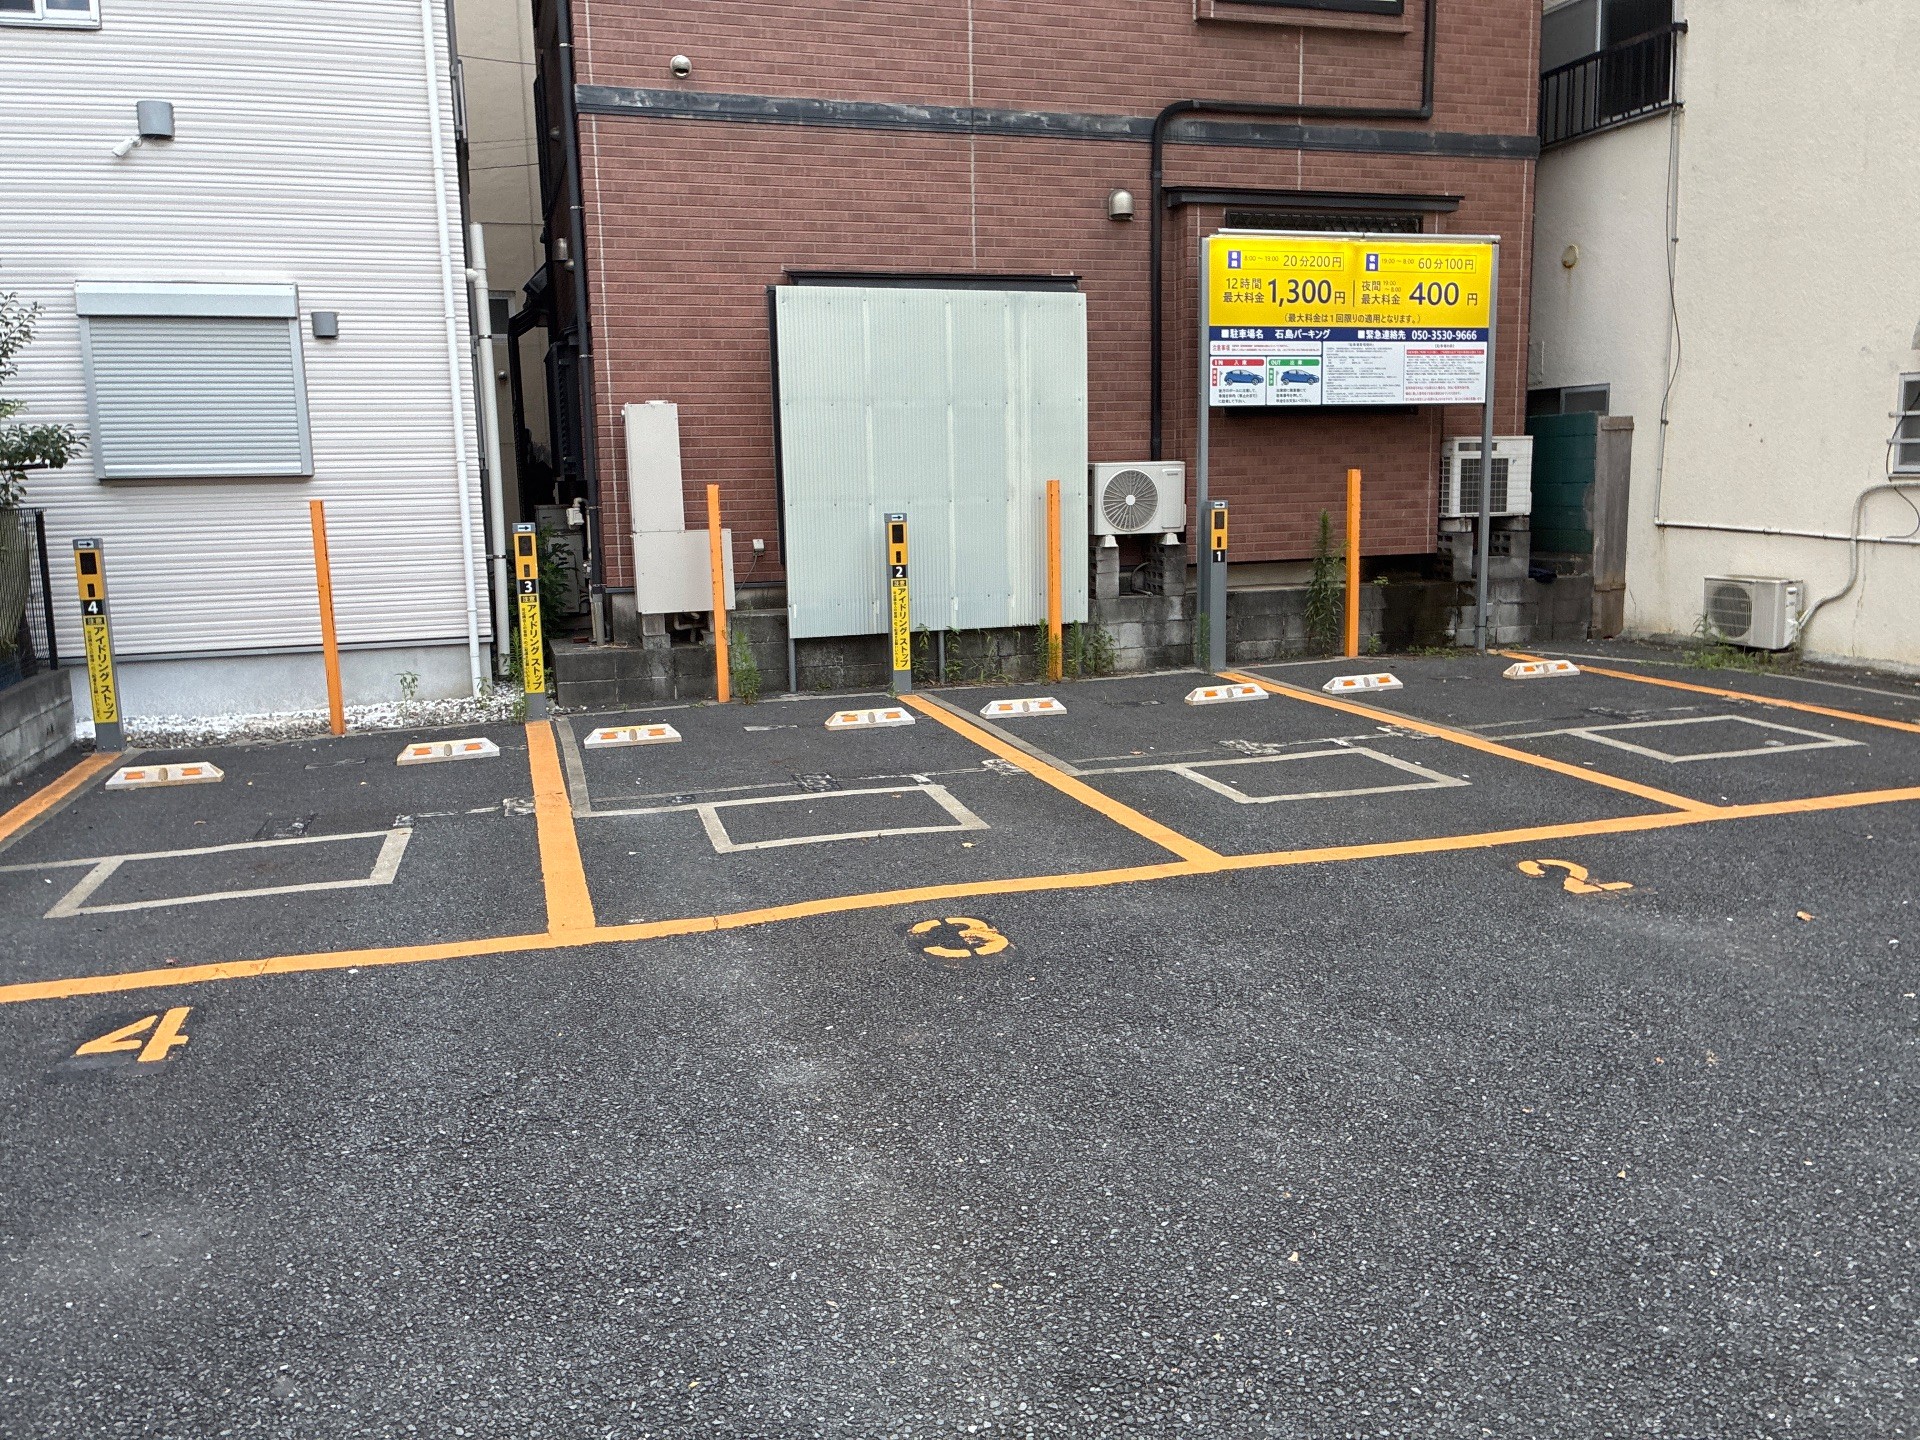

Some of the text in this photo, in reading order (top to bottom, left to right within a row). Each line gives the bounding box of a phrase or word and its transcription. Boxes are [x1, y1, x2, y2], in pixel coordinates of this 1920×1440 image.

[1283, 255, 1342, 268] 20分200円
[1418, 258, 1474, 270] 60分100円
[1226, 278, 1262, 290] 12時間
[1361, 280, 1381, 292] 夜間
[1223, 292, 1265, 304] 最大料金
[1361, 294, 1401, 305] 最大料金
[1274, 329, 1331, 339] 石島パーキング
[1411, 330, 1477, 340] 050-3530-9666
[895, 566, 903, 578] 2
[524, 581, 533, 593] 3
[87, 601, 99, 614] 4
[897, 588, 908, 668] アイドリング ストップ
[527, 604, 542, 691] アイドリング ストップ
[93, 626, 110, 682] アイドリング
[100, 684, 114, 720] ストップ
[1518, 859, 1634, 894] 2
[912, 917, 1009, 958] 3
[76, 1006, 192, 1062] 4
